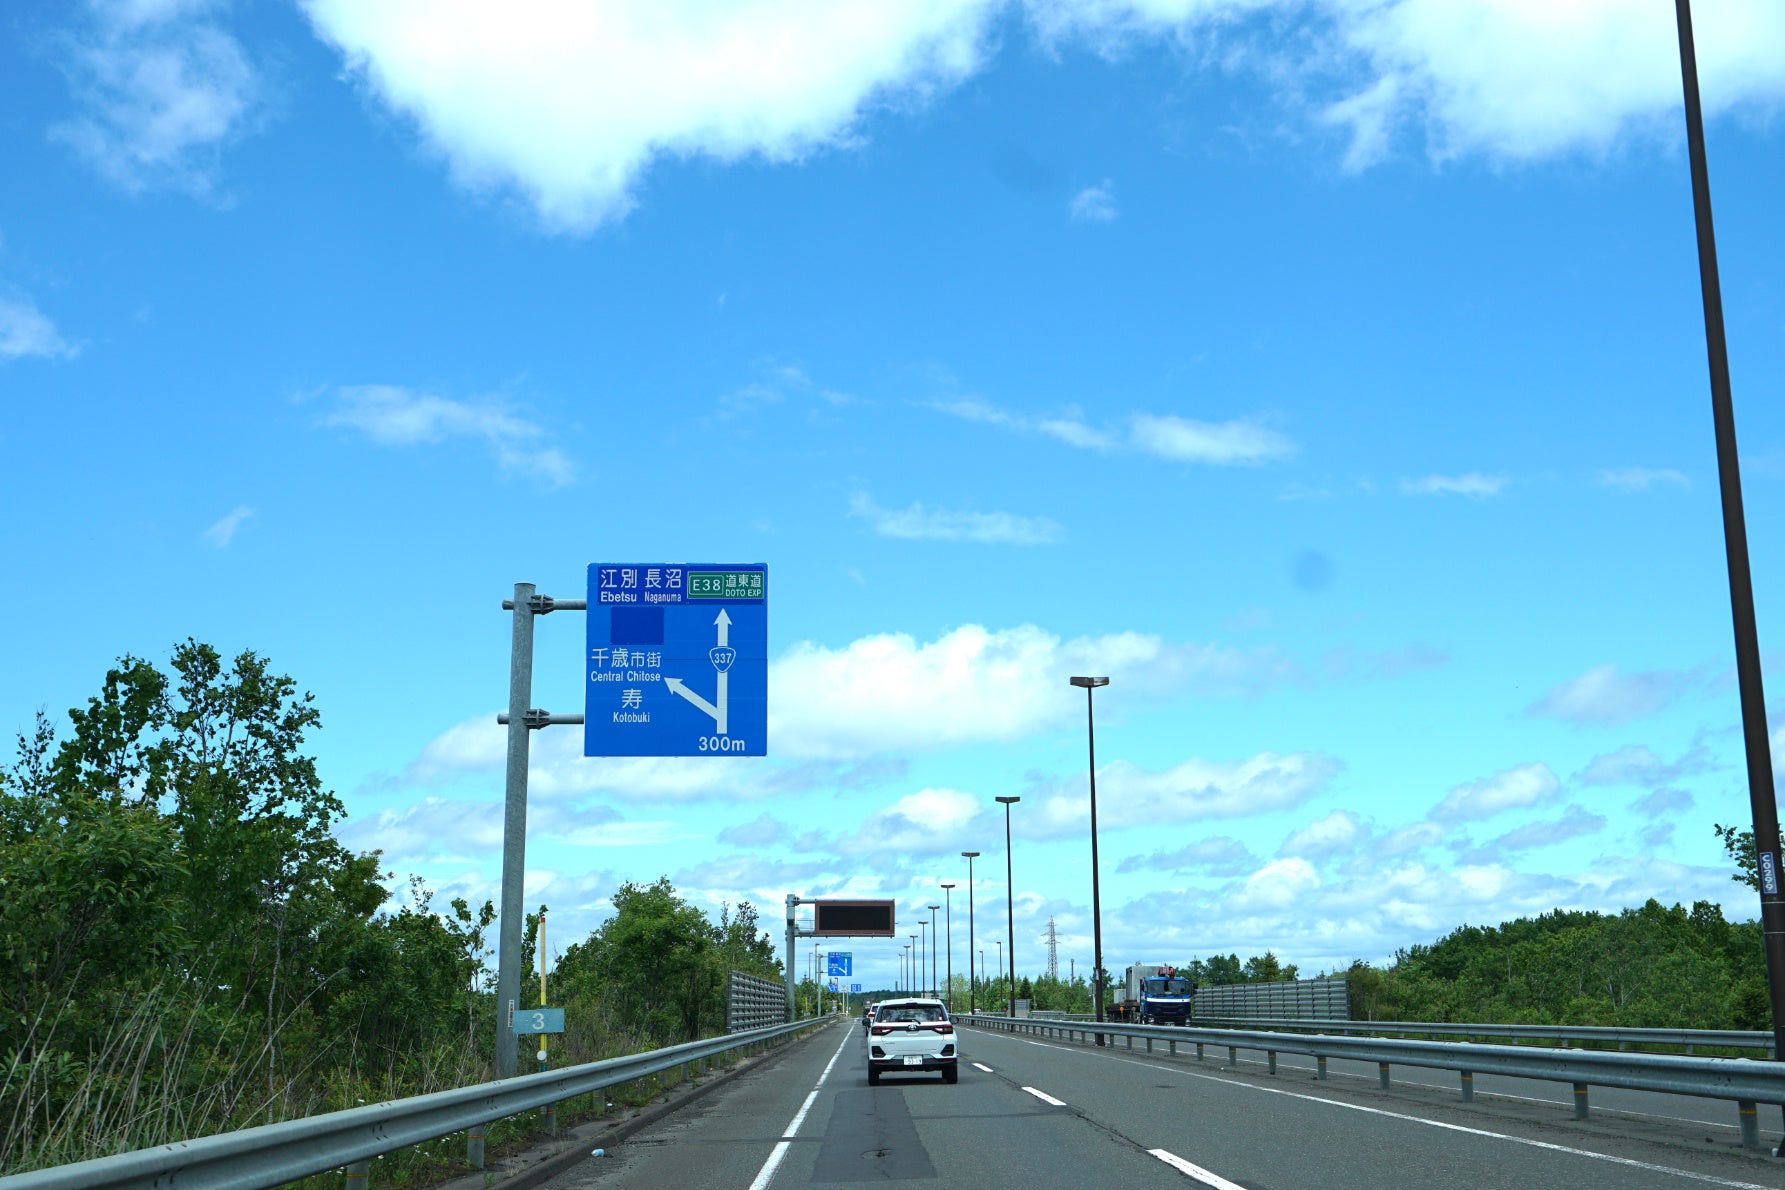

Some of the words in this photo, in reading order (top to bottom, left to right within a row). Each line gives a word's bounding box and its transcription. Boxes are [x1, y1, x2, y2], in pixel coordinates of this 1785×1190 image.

[600, 568, 638, 589] 江別
[644, 568, 682, 589] 長沼
[693, 579, 721, 591] E38
[725, 574, 762, 588] 道東道
[600, 591, 637, 602] Ebetsu
[644, 591, 682, 604] Naganuma
[725, 588, 746, 597] DOTO
[747, 588, 762, 597] EXP
[591, 647, 661, 669] 千歳市街
[714, 652, 731, 664] 337
[590, 670, 624, 682] Central
[626, 670, 661, 682] Chitose
[621, 688, 643, 710] 寿
[613, 711, 651, 723] Kotobuki
[698, 736, 746, 752] 300m
[532, 1012, 545, 1030] 3
